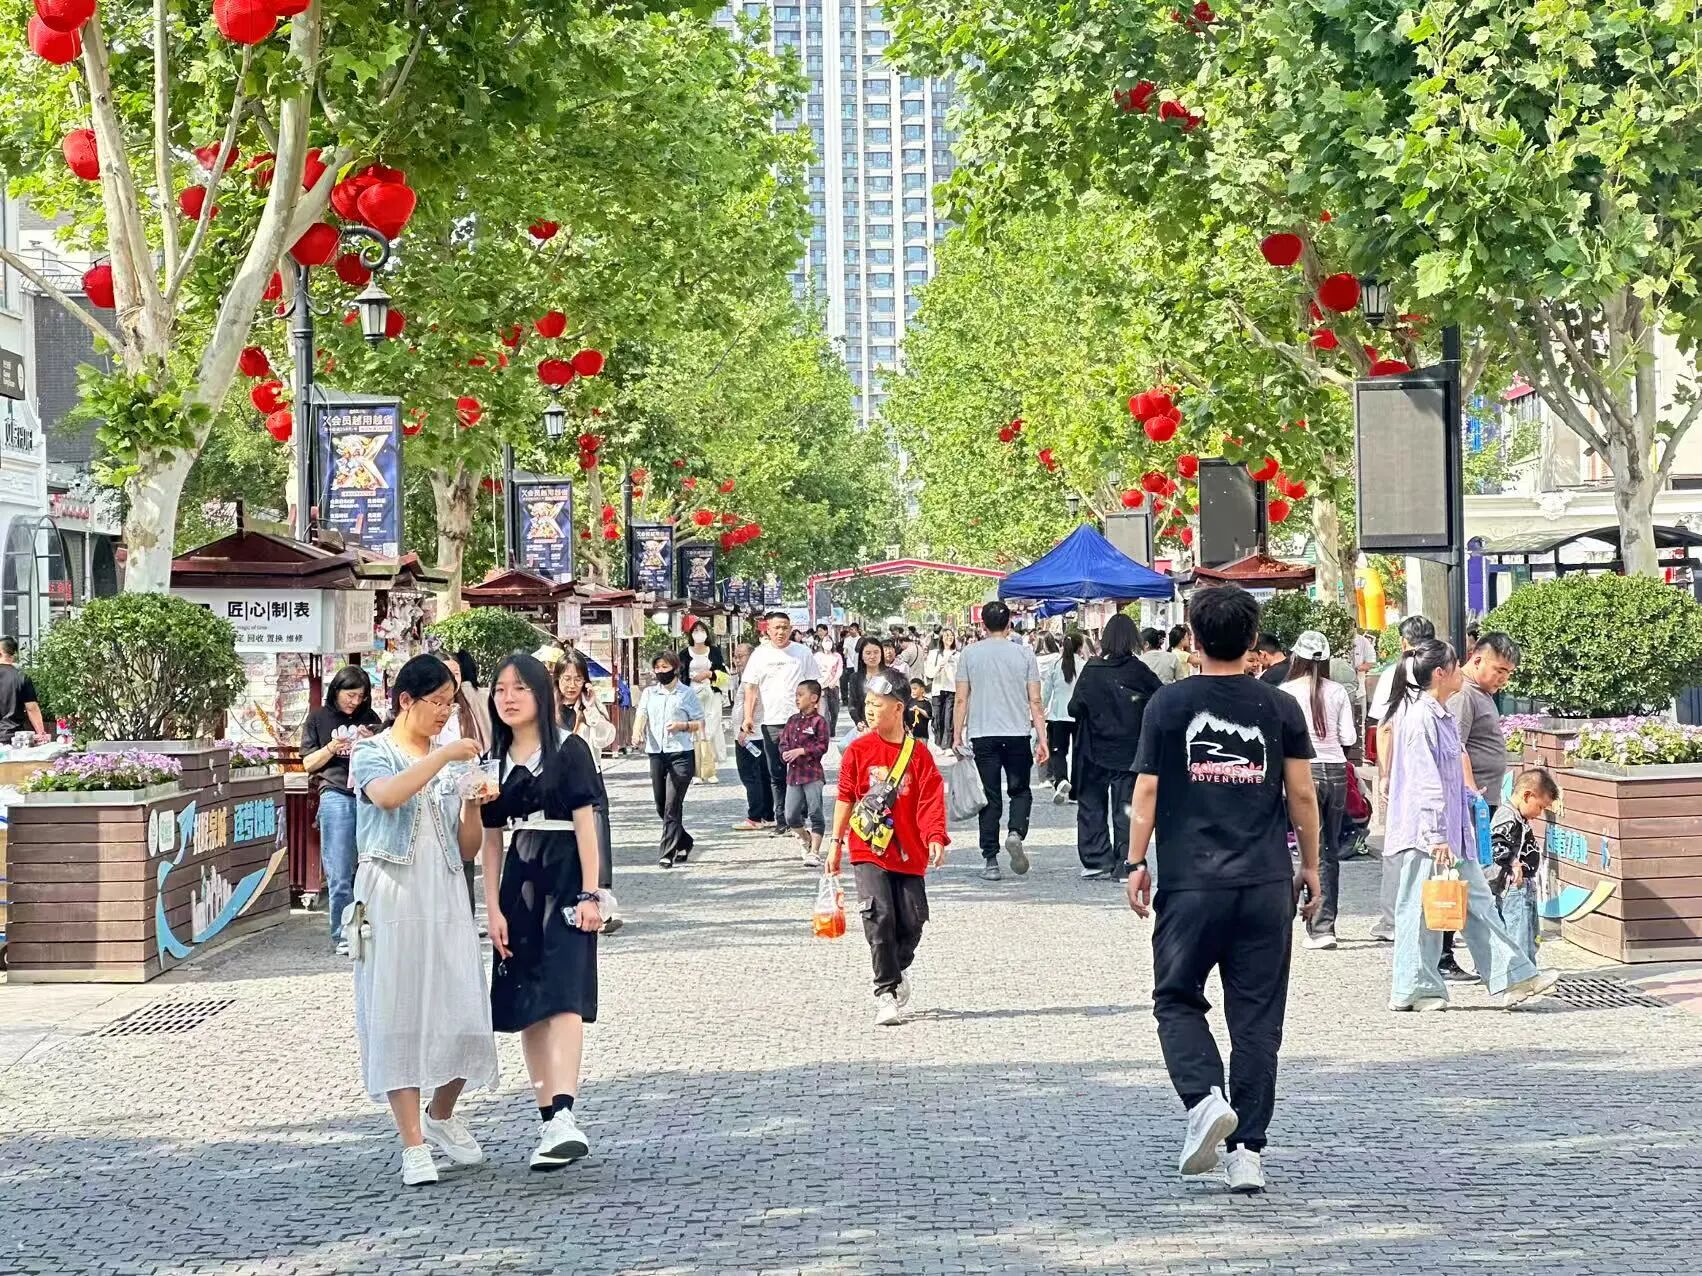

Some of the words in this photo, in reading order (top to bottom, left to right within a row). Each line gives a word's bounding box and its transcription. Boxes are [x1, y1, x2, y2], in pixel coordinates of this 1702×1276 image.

[247, 634, 264, 642] 回收
[267, 634, 284, 642] 置换
[286, 634, 304, 642] 维修
[1191, 774, 1262, 784] ADVENTURE
